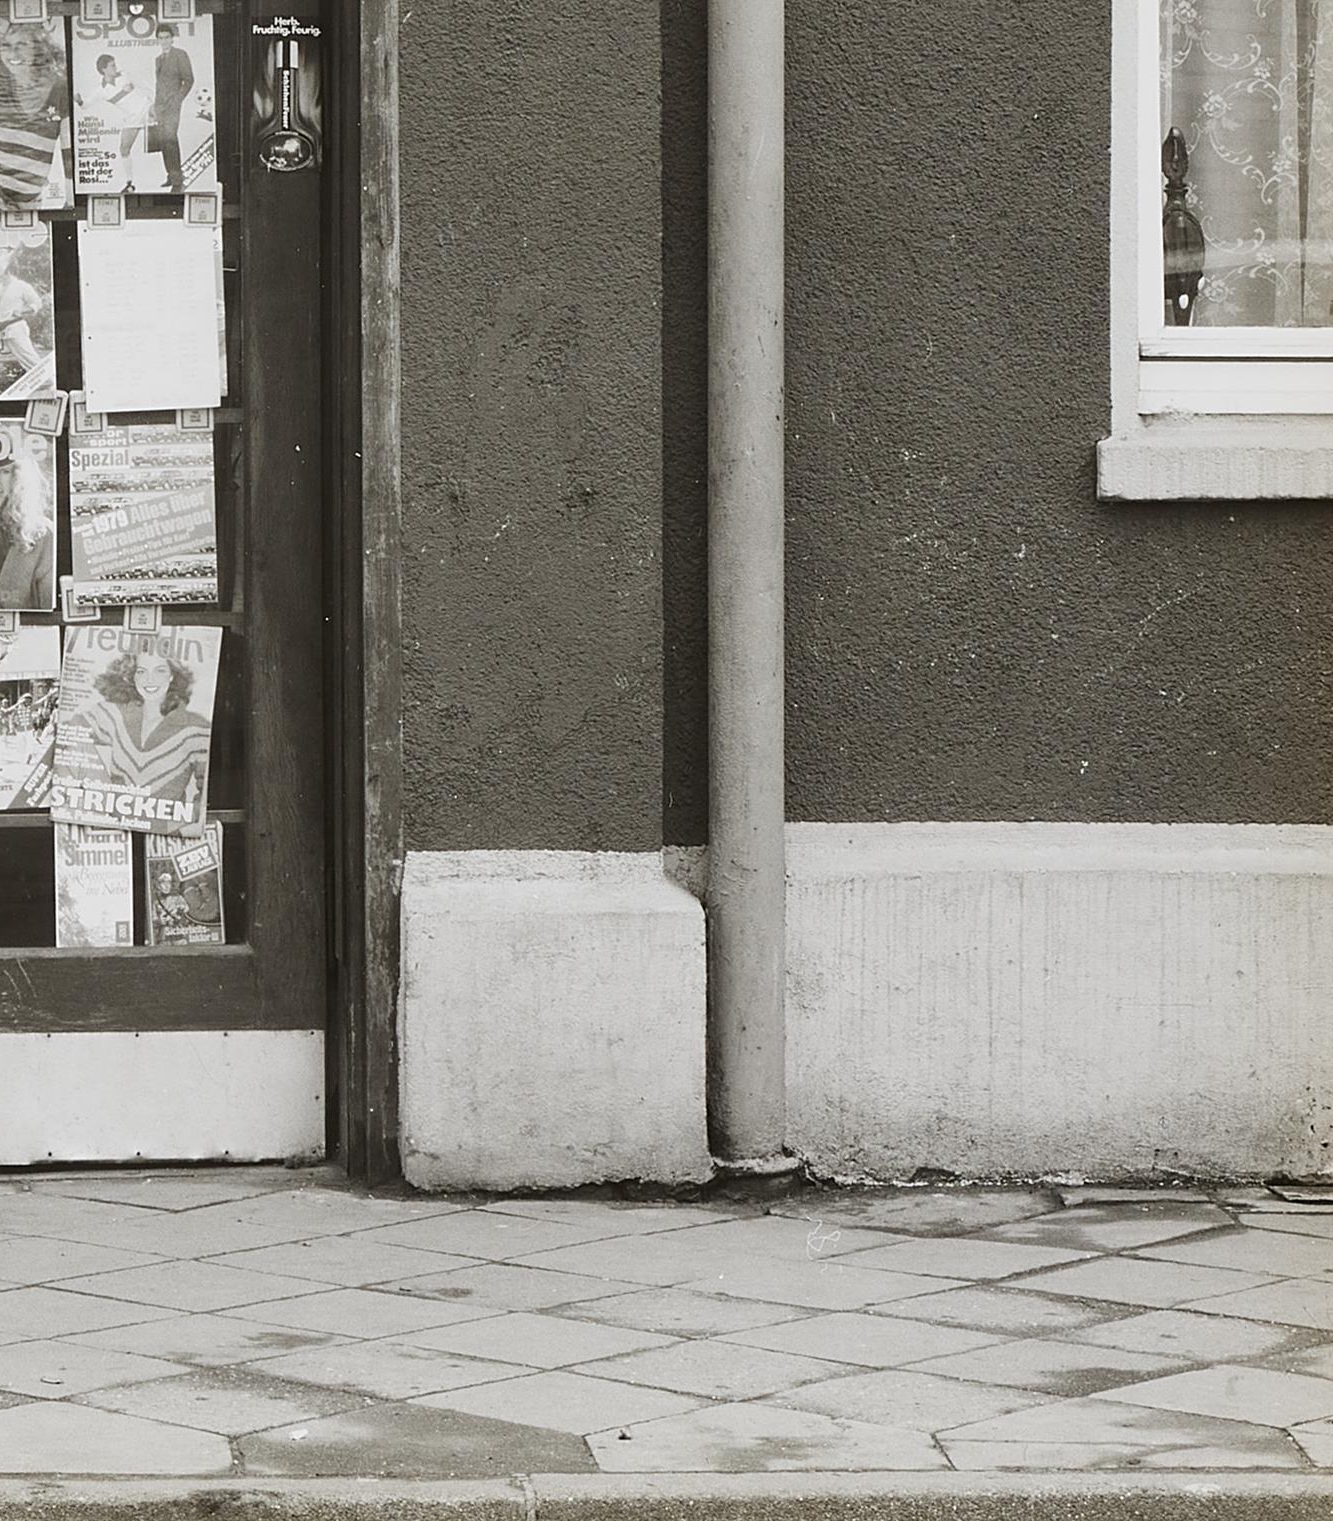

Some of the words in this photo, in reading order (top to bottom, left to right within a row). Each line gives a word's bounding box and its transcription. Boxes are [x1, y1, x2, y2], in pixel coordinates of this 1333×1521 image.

[274, 16, 300, 26] Herb.
[76, 16, 195, 41] SPOT
[252, 25, 290, 37] Fruchtig.
[291, 25, 321, 37] Feurig.
[106, 39, 160, 48] ILLUSTRIER
[77, 135, 101, 144] wird
[78, 160, 91, 168] ist
[91, 160, 110, 168] das
[78, 168, 95, 176] mit
[96, 167, 113, 175] der
[88, 437, 127, 448] sport
[71, 449, 129, 471] Spezial
[91, 508, 130, 534] 1979
[130, 500, 171, 524] Alles
[169, 491, 207, 512] über
[83, 508, 213, 556] Gebrauchtwagen
[49, 785, 195, 823] STRICKEN
[65, 844, 129, 867] Simmel
